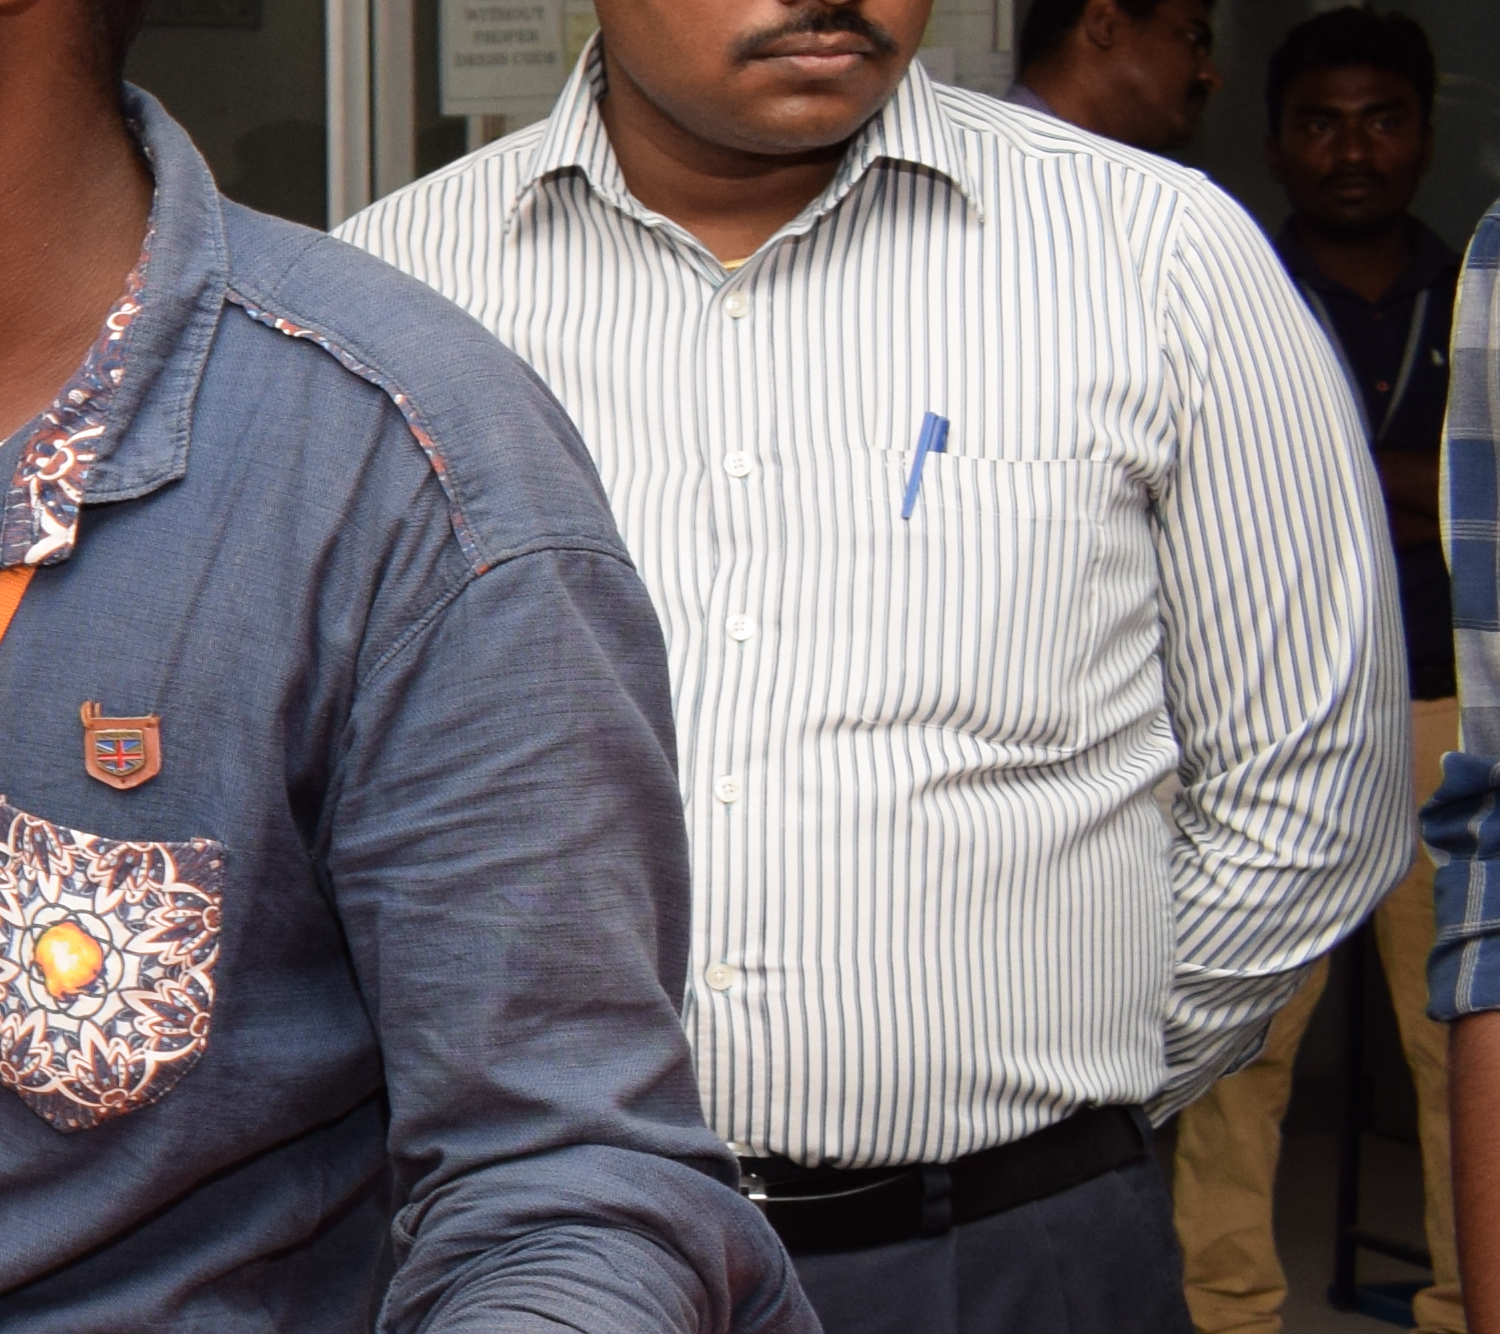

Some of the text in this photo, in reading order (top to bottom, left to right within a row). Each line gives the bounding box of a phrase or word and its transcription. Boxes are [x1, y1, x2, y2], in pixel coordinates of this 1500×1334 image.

[465, 5, 544, 21] WITHOUT
[473, 28, 539, 44] PROPER
[511, 51, 556, 66] CODE
